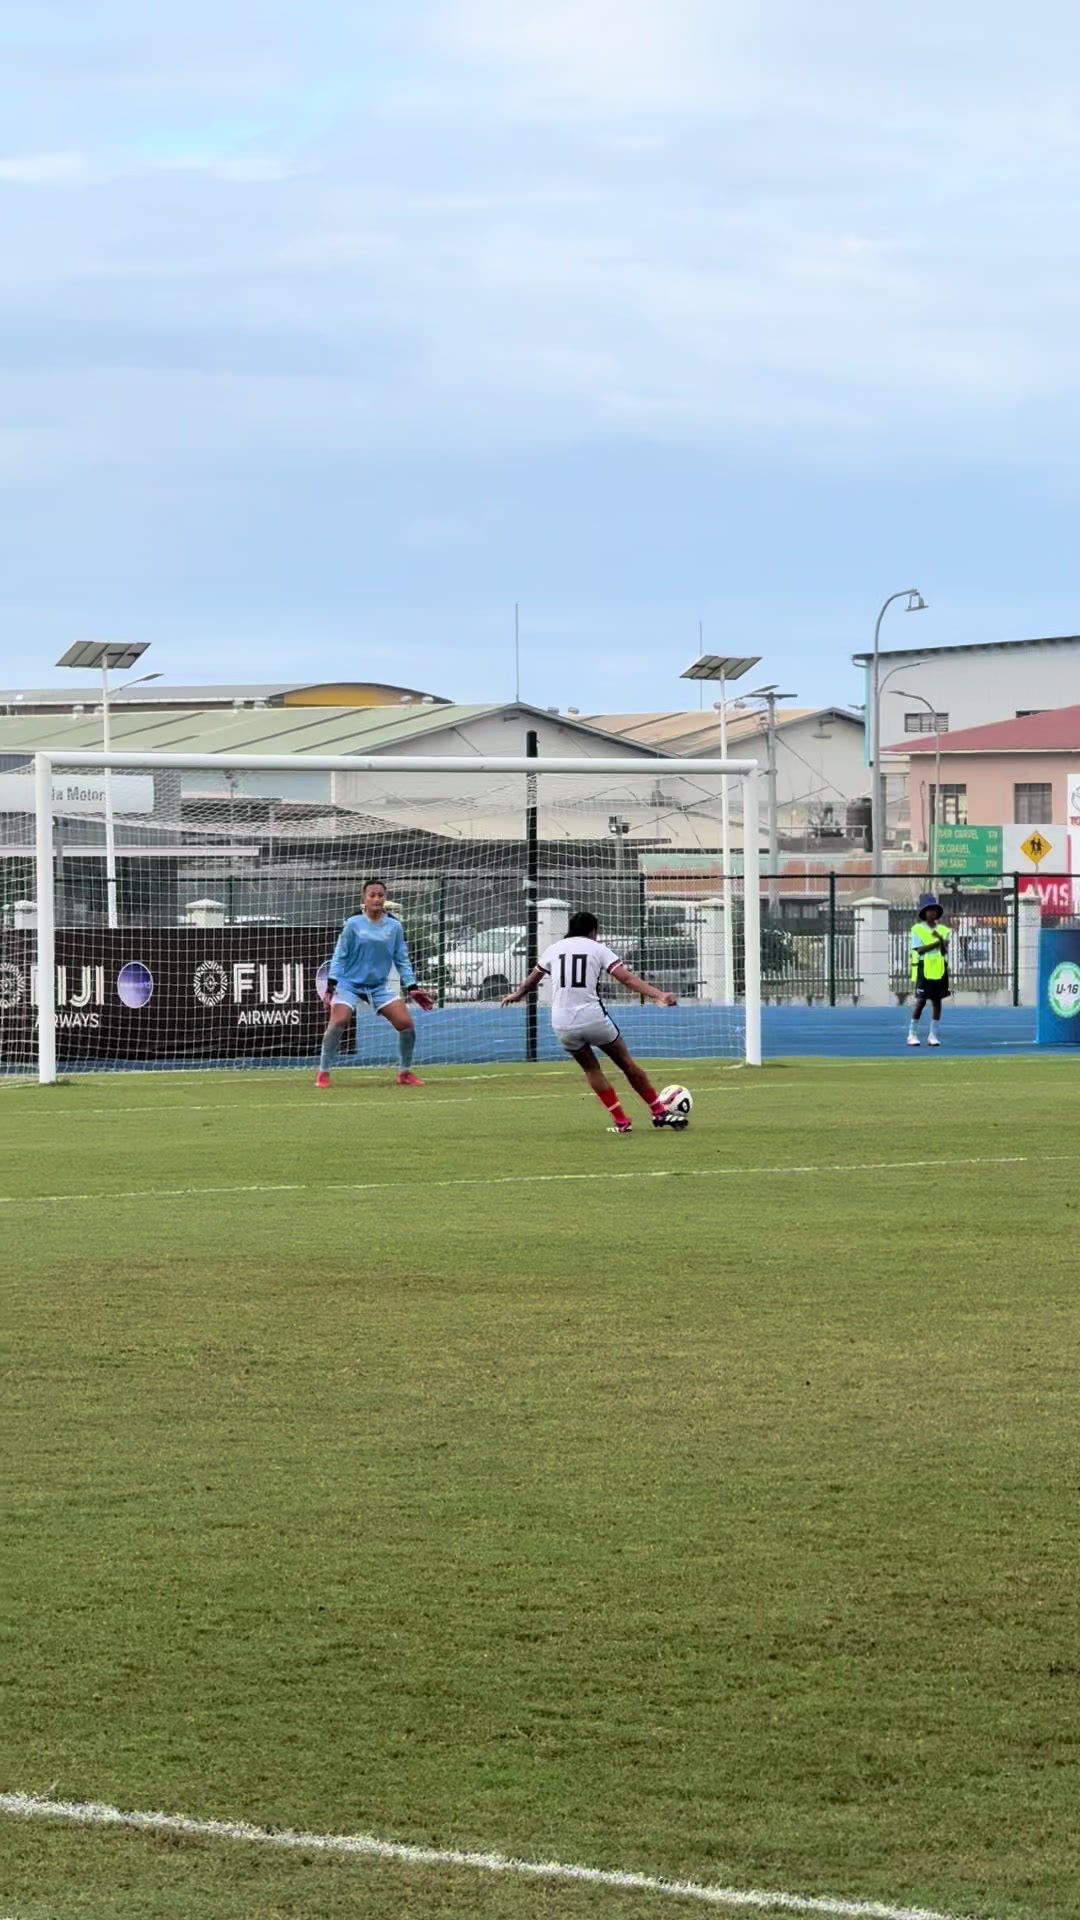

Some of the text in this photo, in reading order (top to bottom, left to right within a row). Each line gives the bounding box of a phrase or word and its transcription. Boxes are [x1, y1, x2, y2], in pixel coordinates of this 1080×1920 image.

[51, 786, 63, 801] ia
[559, 953, 588, 988] 10
[233, 962, 304, 1004] FIJI
[1056, 983, 1079, 995] U-16
[35, 1013, 99, 1028] RWAYS
[238, 1010, 300, 1025] AIRWAYS
